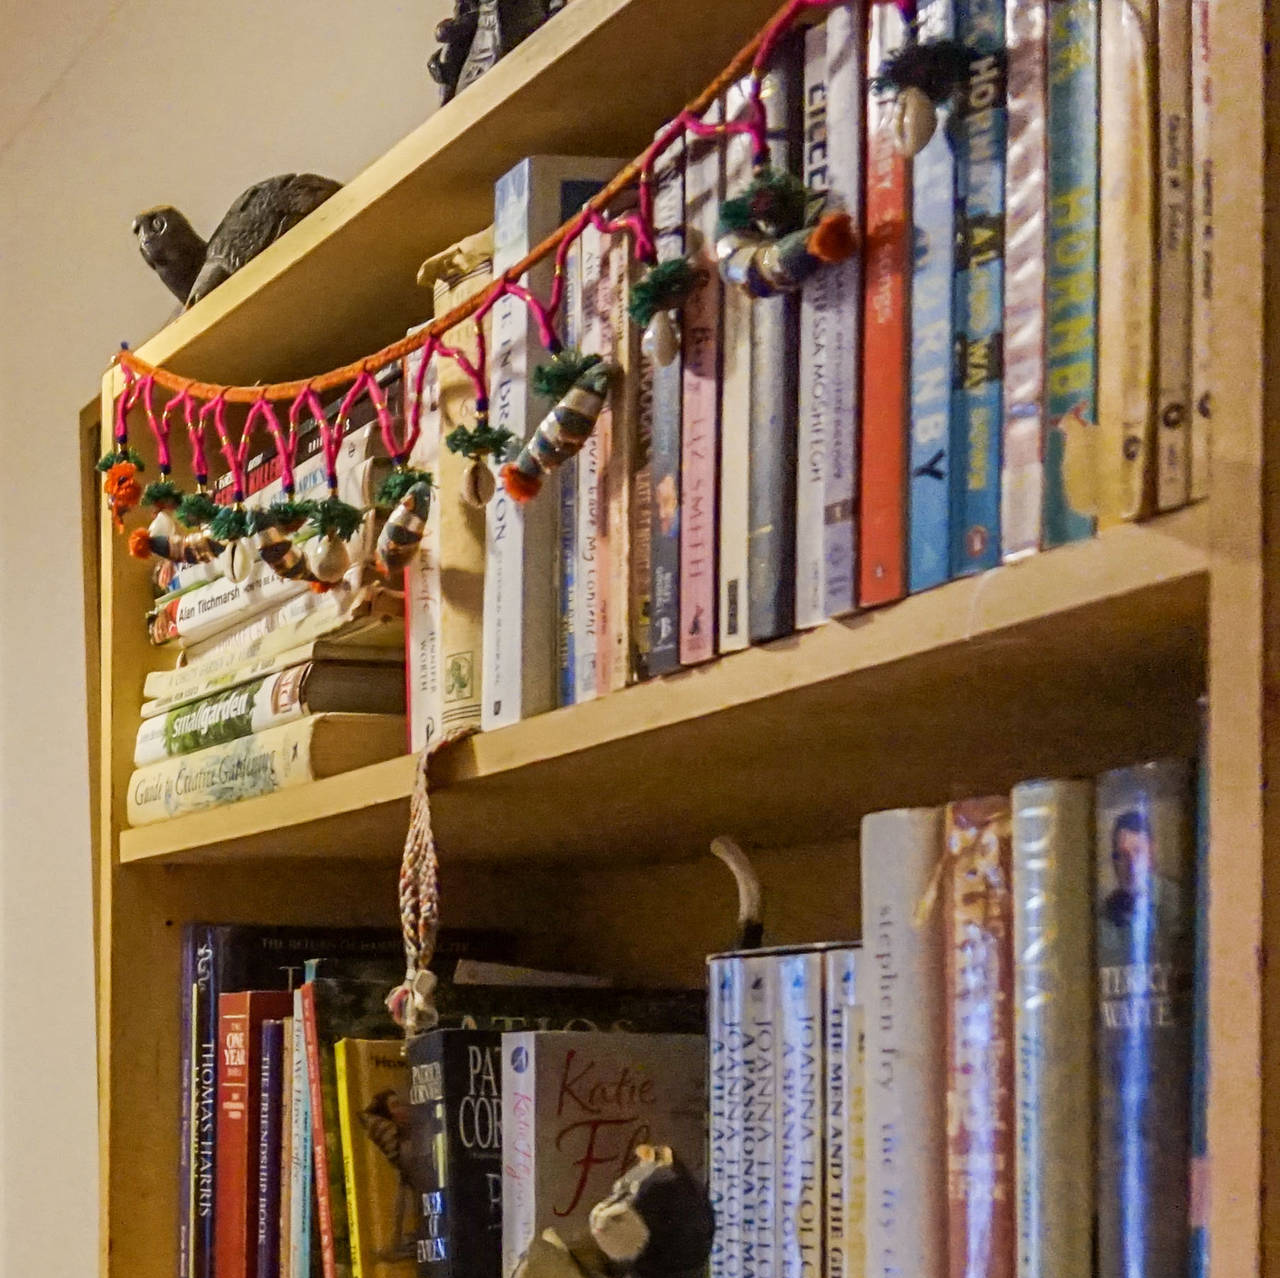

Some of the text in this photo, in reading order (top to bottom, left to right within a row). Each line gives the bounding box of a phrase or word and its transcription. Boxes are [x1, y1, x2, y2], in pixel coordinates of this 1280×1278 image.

[179, 607, 195, 623] Alan
[198, 586, 240, 615] Titchmarsh
[224, 1049, 246, 1066] YEAR
[226, 1032, 244, 1049] ONE
[830, 1008, 843, 1054] THE
[258, 1056, 271, 1084] THE
[557, 1048, 657, 1116] Katie
[755, 1021, 773, 1142] JOANNA
[798, 1016, 818, 1140] JOANNA
[830, 1064, 843, 1118] MEN
[199, 1042, 215, 1217] THOMAS HARRIS
[258, 1092, 271, 1194] FRIENDSHIP
[742, 1058, 756, 1246] PASSIONATE
[781, 1065, 796, 1192] SPANISH
[830, 1126, 843, 1181] AND
[257, 1197, 270, 1246] BOOK
[830, 1189, 843, 1239] THE
